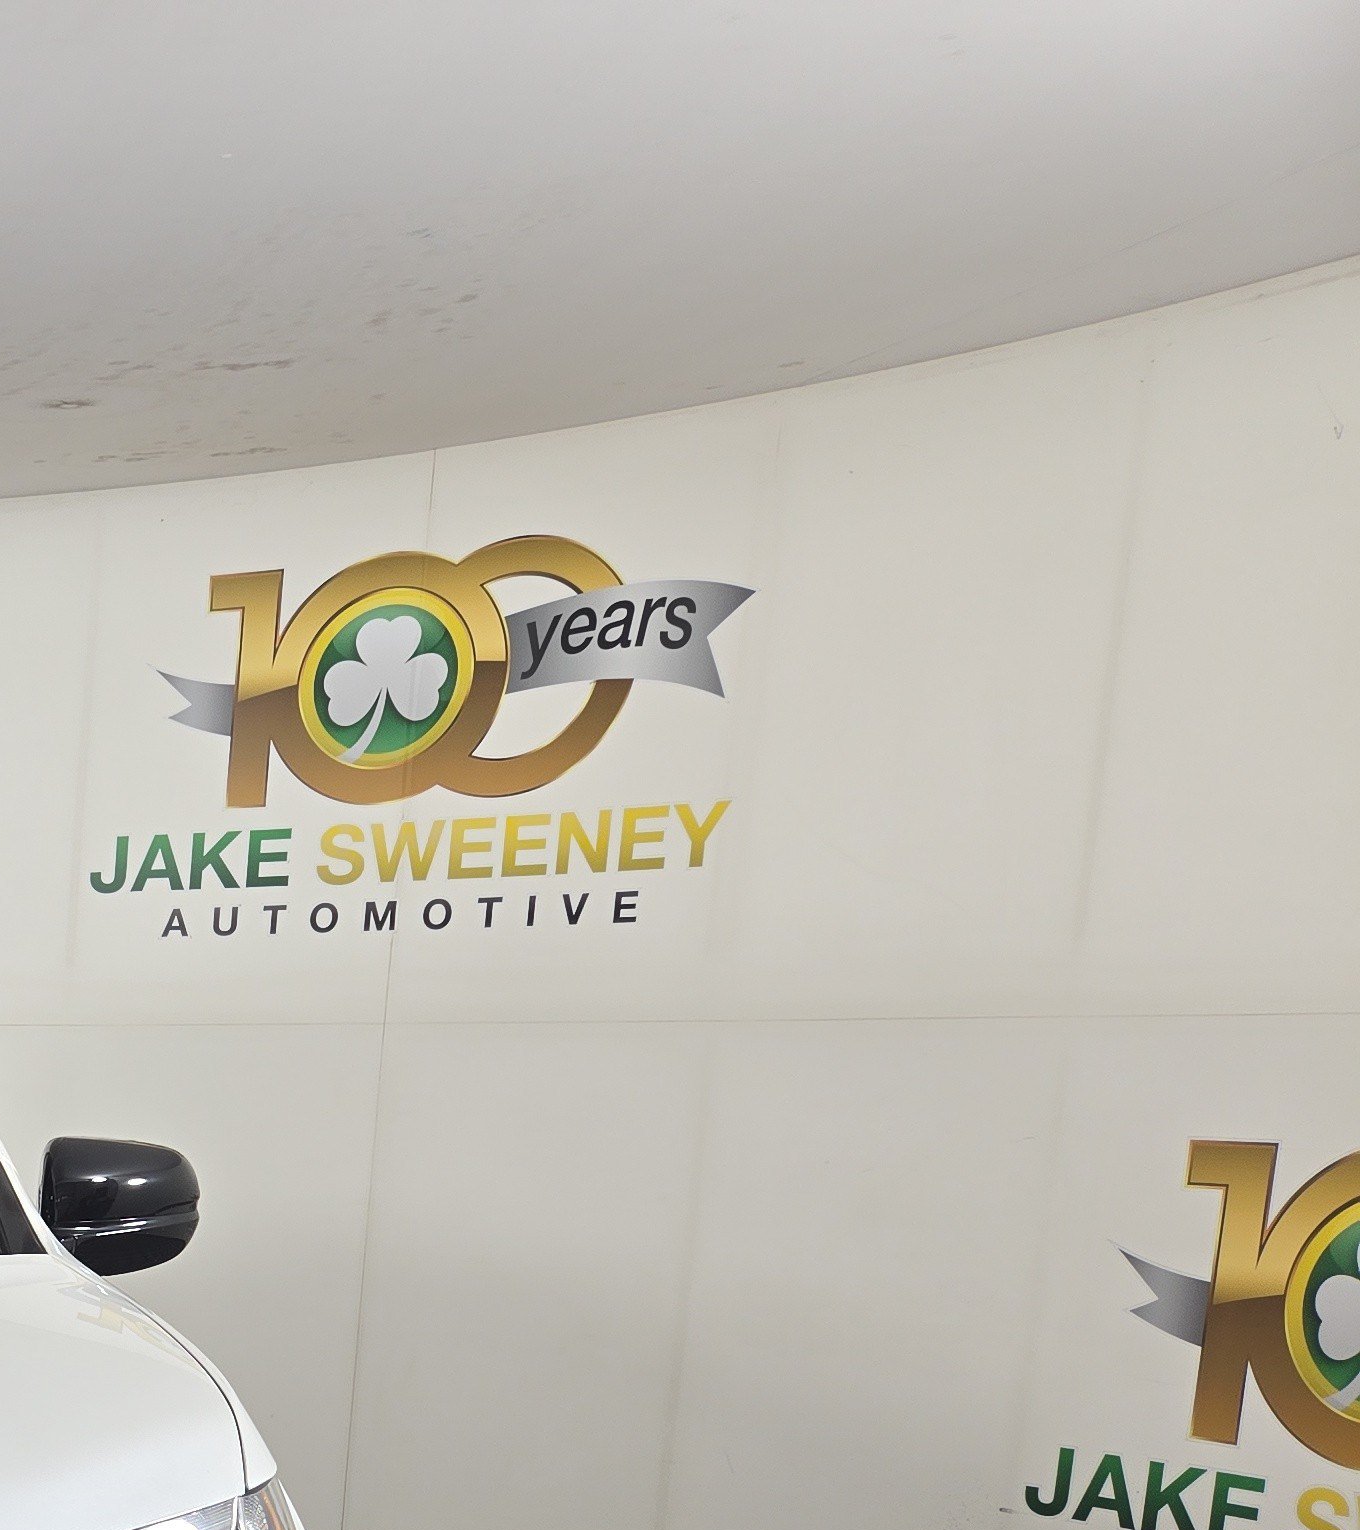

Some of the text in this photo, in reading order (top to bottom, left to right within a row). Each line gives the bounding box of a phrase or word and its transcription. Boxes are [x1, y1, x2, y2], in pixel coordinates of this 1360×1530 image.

[209, 535, 697, 809] 100 years
[89, 800, 732, 894] JAKE SWEENEY
[161, 890, 639, 938] AUTOMOTIVE
